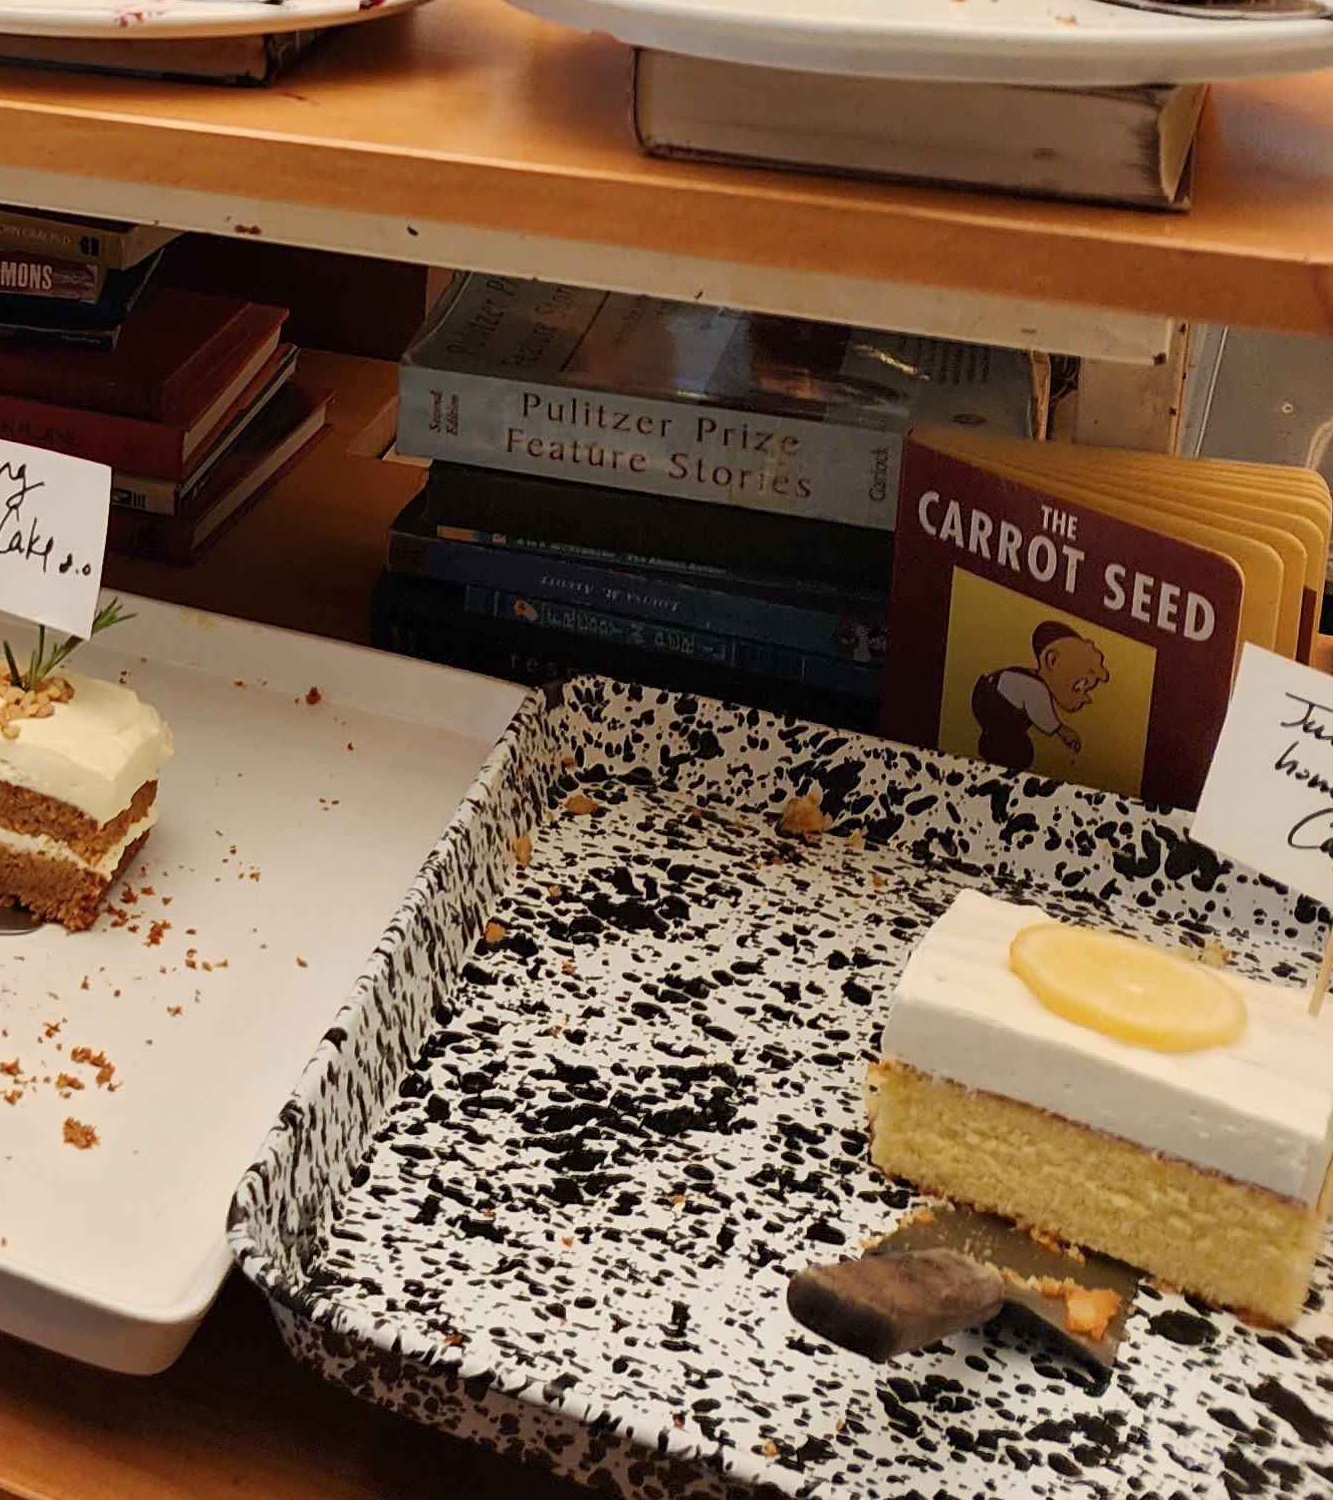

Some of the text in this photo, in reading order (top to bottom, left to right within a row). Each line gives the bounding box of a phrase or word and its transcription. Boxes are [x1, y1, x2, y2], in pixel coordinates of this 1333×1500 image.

[523, 392, 802, 458] Pulitzer Prize
[506, 427, 813, 499] Feature Stories
[1041, 503, 1079, 543] THE
[918, 490, 1216, 643] CARROT SEED
